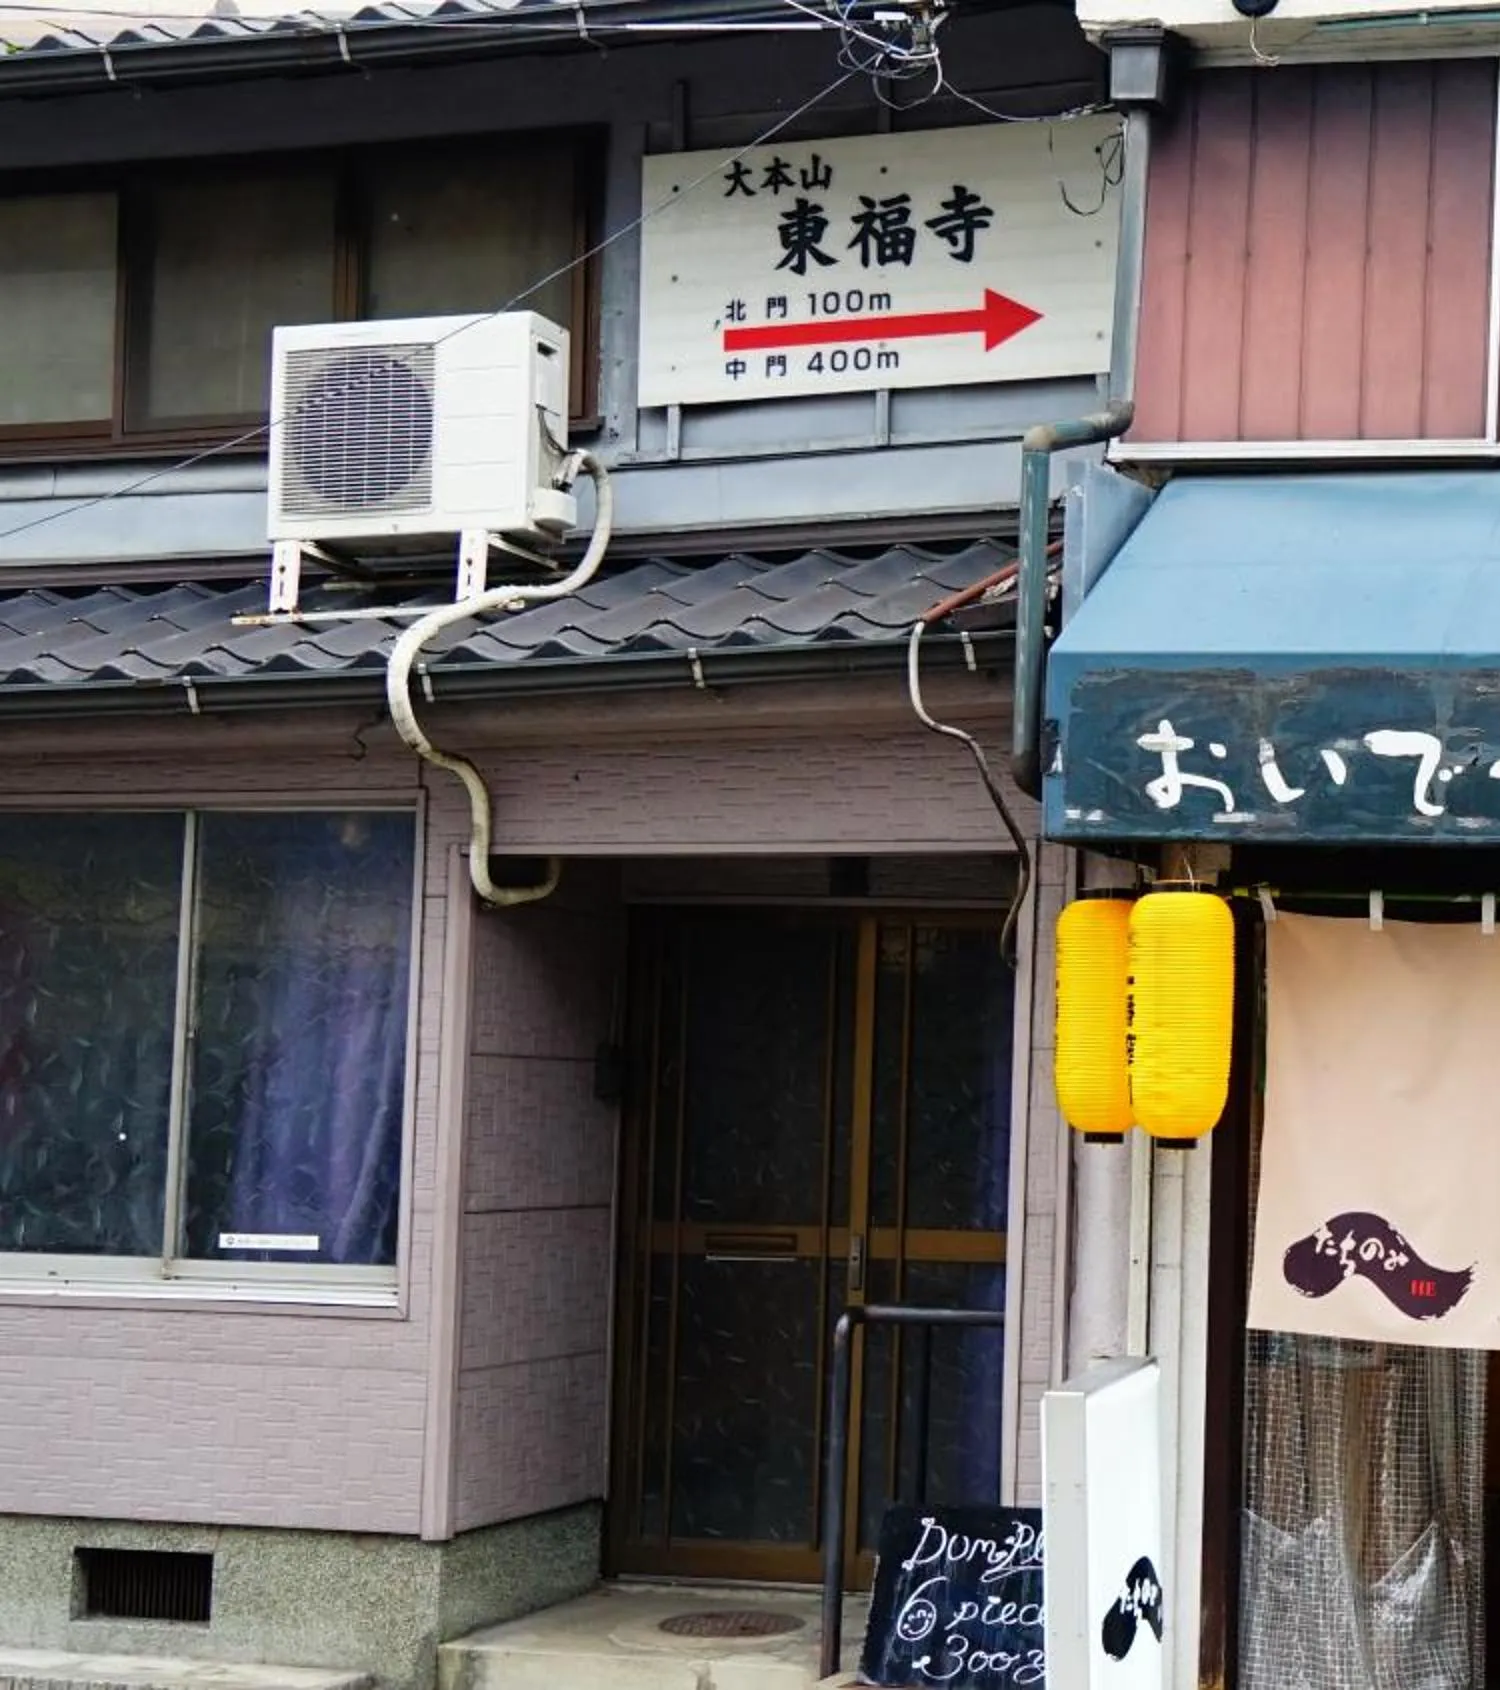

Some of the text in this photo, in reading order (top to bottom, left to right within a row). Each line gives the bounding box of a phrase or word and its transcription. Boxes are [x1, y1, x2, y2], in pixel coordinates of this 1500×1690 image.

[723, 153, 833, 198] 大本山
[775, 185, 994, 275] 東福寺
[725, 289, 891, 322] 北門 100m
[725, 348, 900, 381] 中門 400m
[1409, 1279, 1436, 1298] HE
[945, 1596, 1044, 1631] piec
